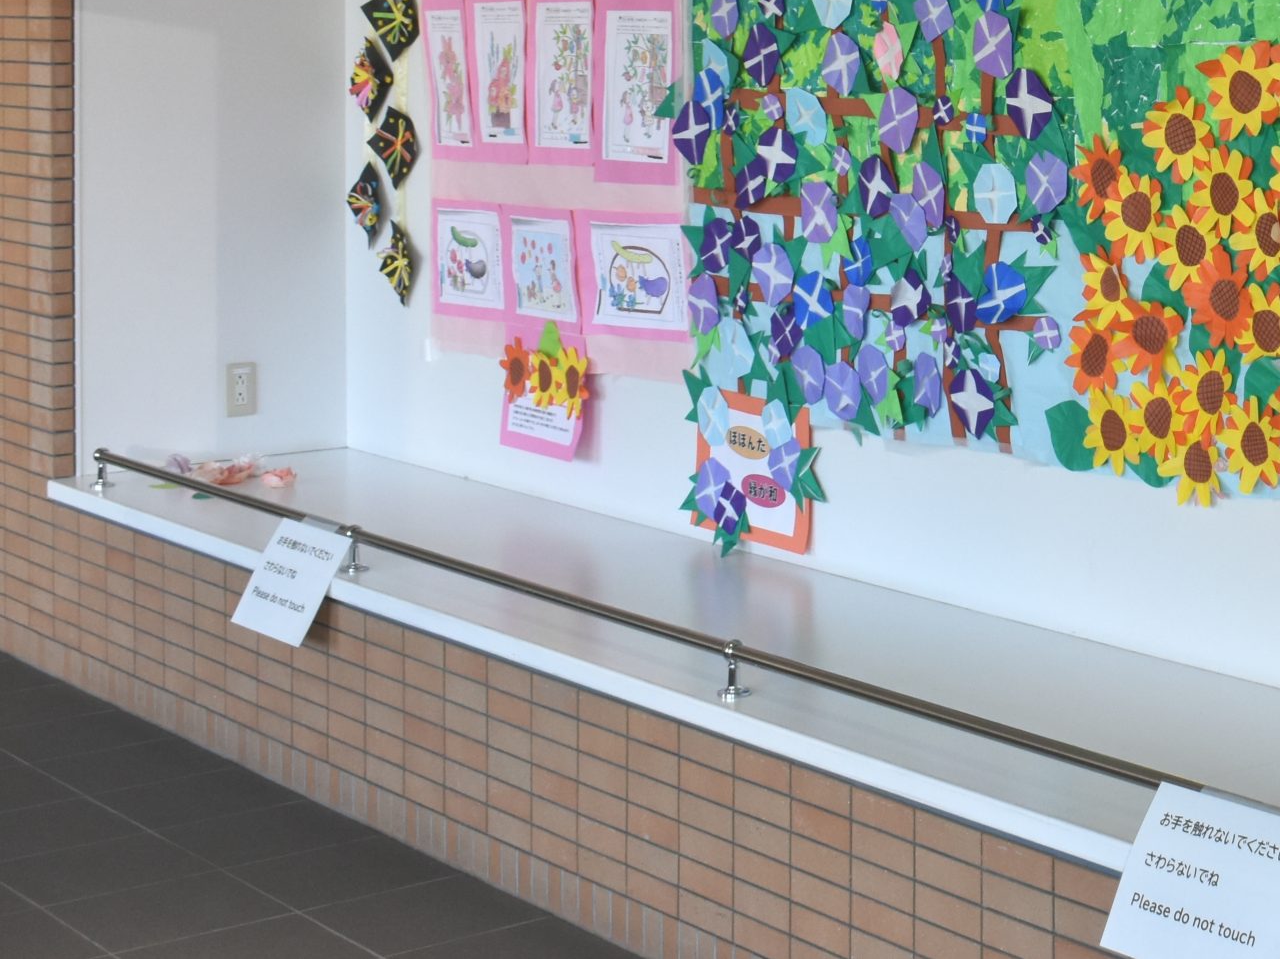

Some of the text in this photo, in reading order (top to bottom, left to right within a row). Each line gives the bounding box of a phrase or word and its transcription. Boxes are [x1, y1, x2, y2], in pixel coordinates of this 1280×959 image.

[252, 586, 305, 612] Please do not touch
[1144, 851, 1220, 887] さわらないでね
[1130, 892, 1256, 947] Please do not touch
